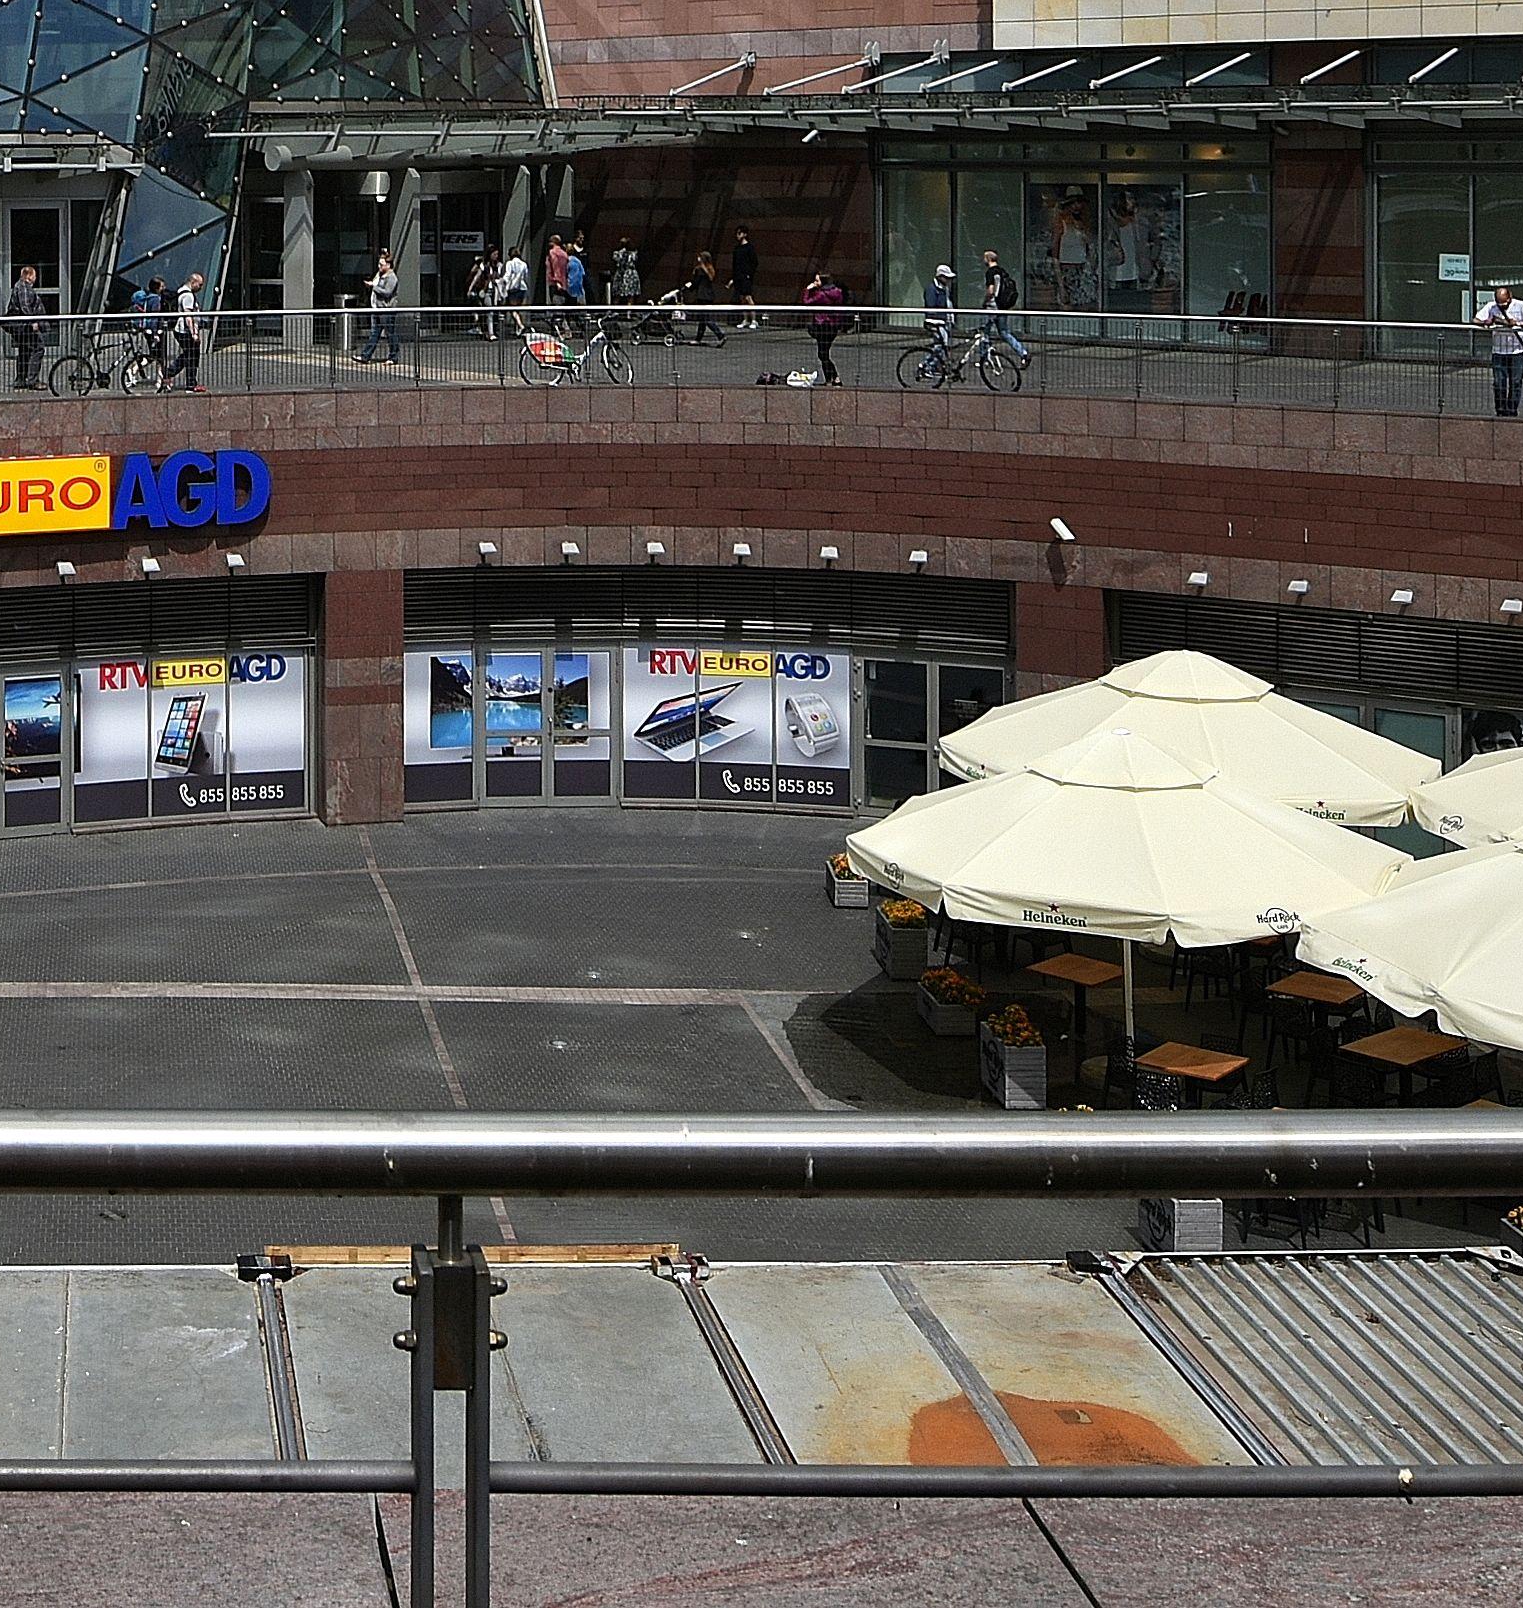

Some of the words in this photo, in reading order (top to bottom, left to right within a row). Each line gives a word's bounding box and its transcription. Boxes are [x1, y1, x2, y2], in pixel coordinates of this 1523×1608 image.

[111, 448, 272, 530] AGD
[99, 662, 149, 691] RTV
[155, 661, 223, 680] EURO
[229, 653, 286, 683] AGD
[649, 650, 698, 675] RTV
[704, 655, 768, 672] EURO
[775, 653, 830, 681] AGD
[200, 787, 224, 805] 855
[232, 785, 257, 803] 855
[259, 783, 284, 801] 855
[743, 777, 770, 794] 855
[778, 778, 805, 795] 855
[807, 779, 834, 796] 855
[1023, 909, 1087, 927] Heineken
[1257, 913, 1277, 923] Hard
